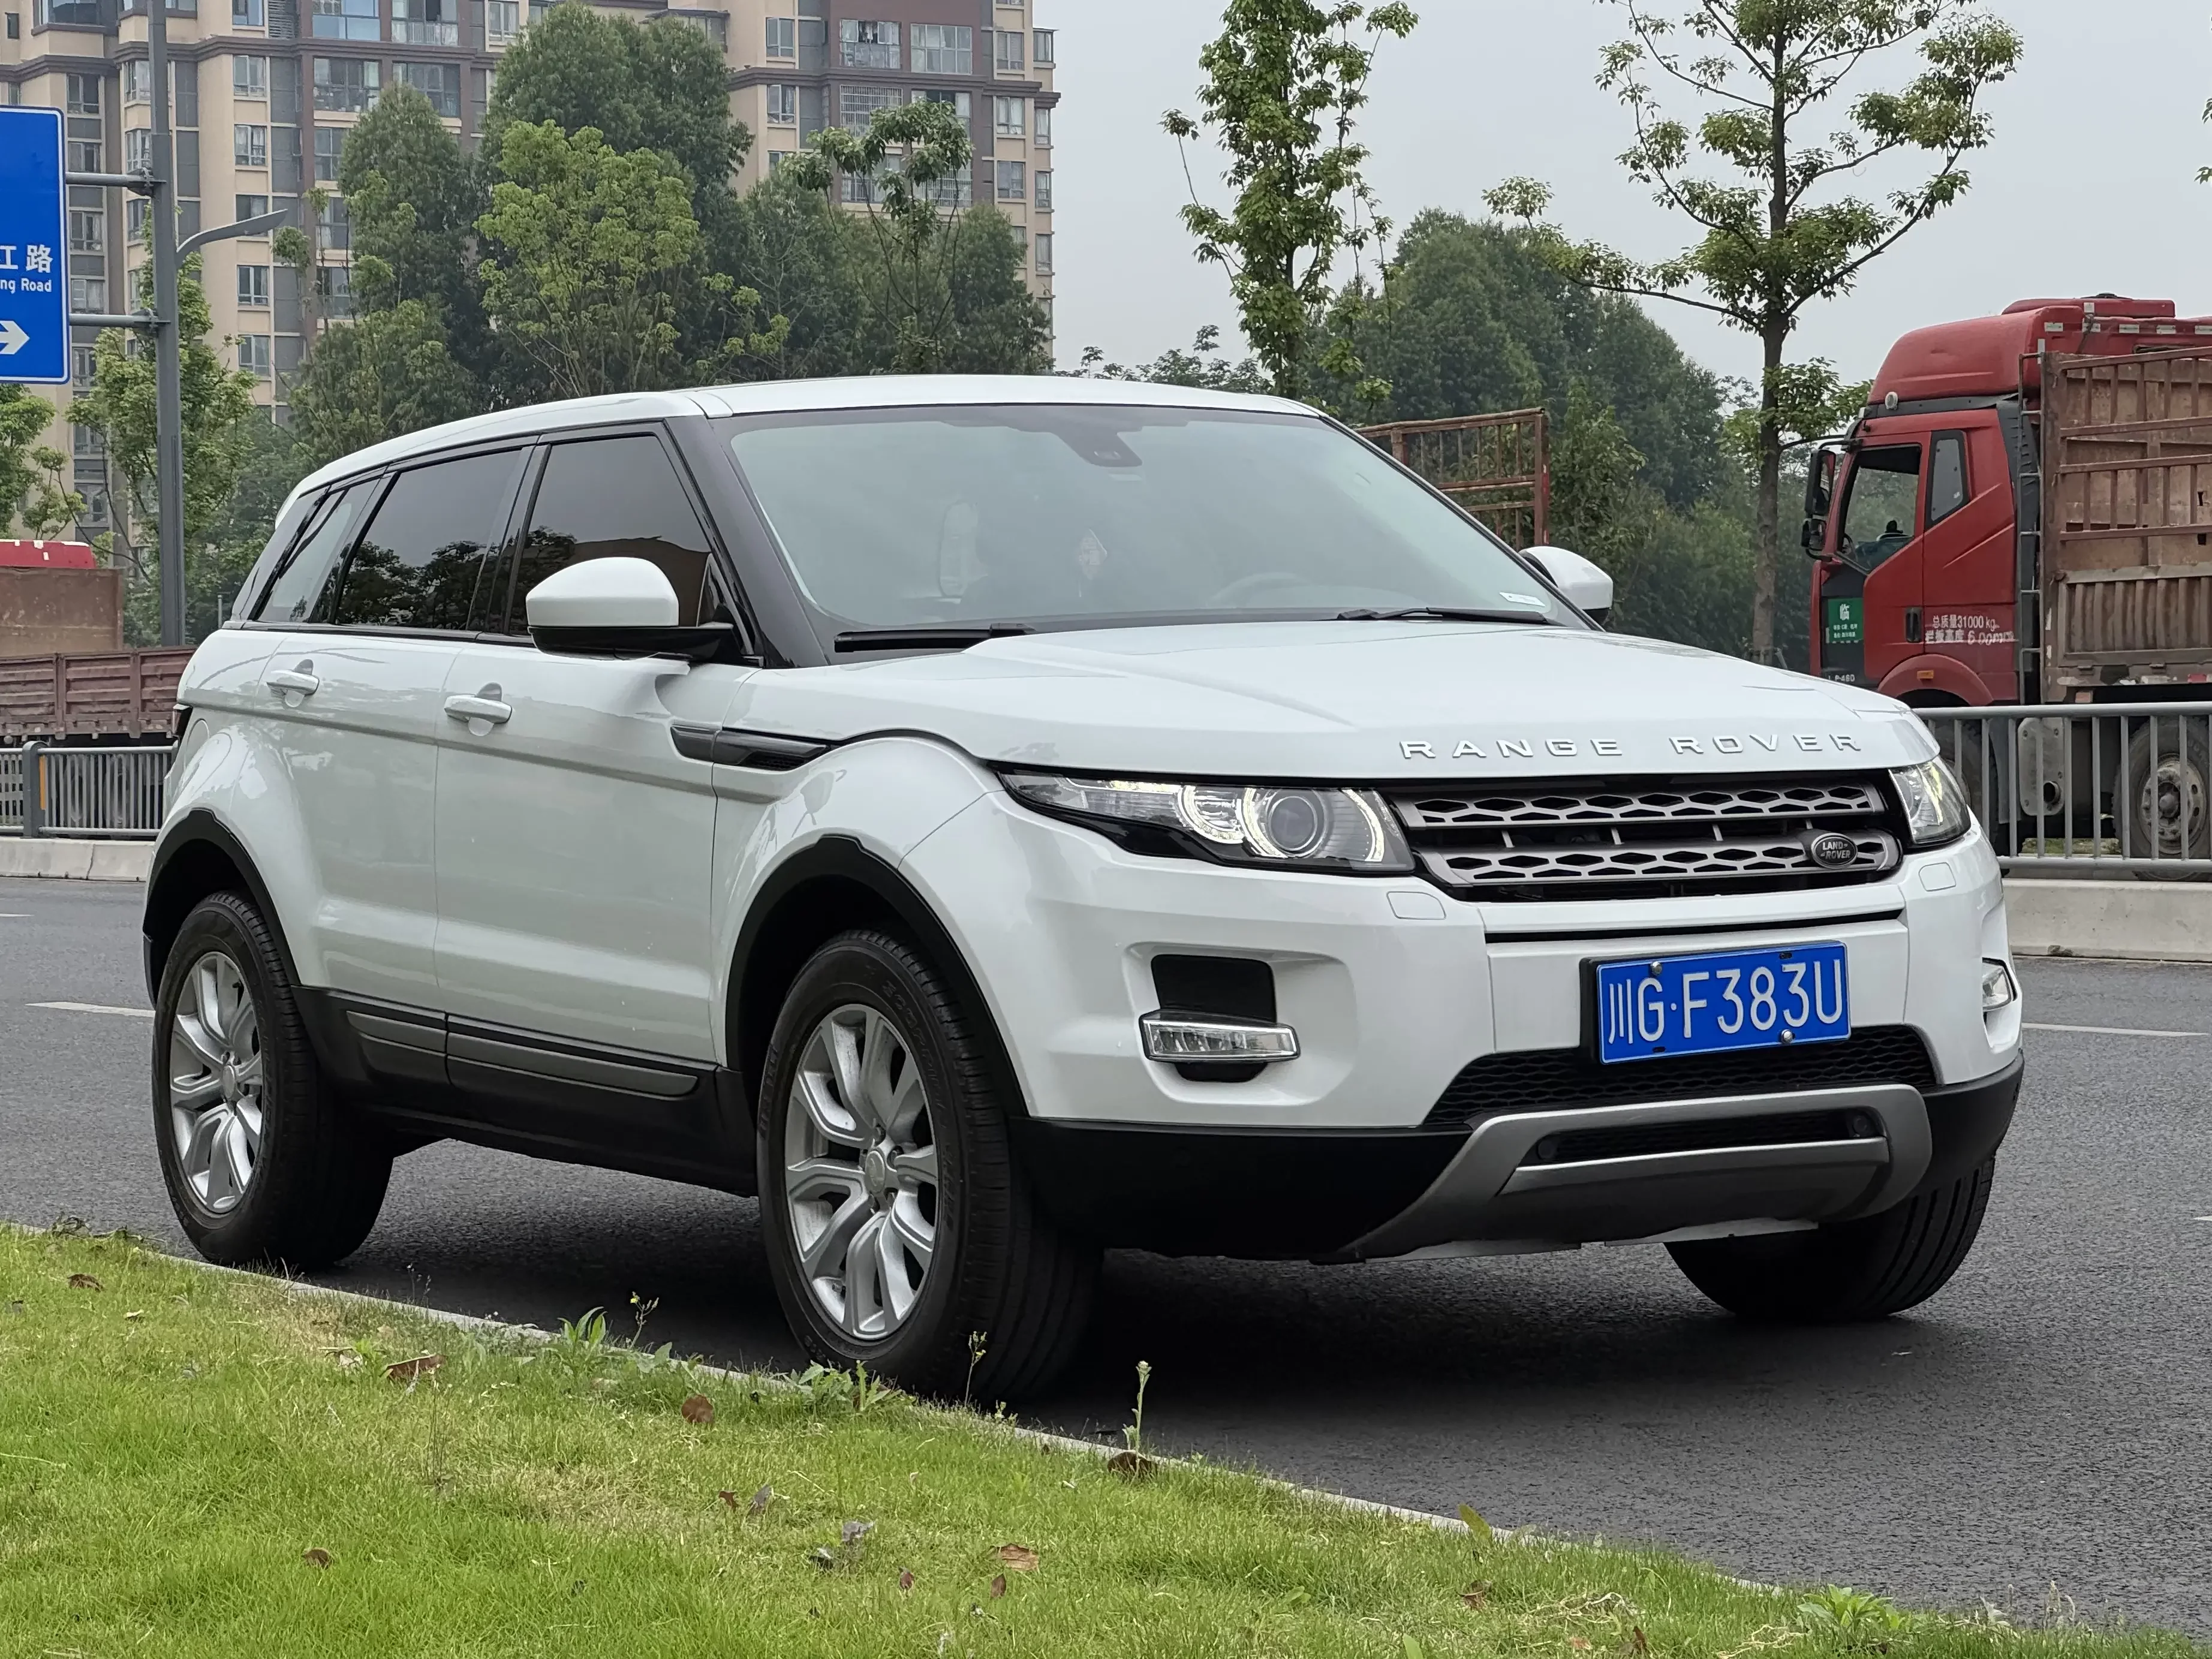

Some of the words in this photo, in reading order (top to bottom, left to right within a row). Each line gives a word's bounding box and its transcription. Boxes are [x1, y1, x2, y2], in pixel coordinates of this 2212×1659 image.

[22, 278, 52, 292] Road
[1400, 739, 1623, 758] RANGE
[1669, 733, 1862, 754] ROVER
[1823, 841, 1843, 850] LAND
[1825, 850, 1850, 860] ROVER
